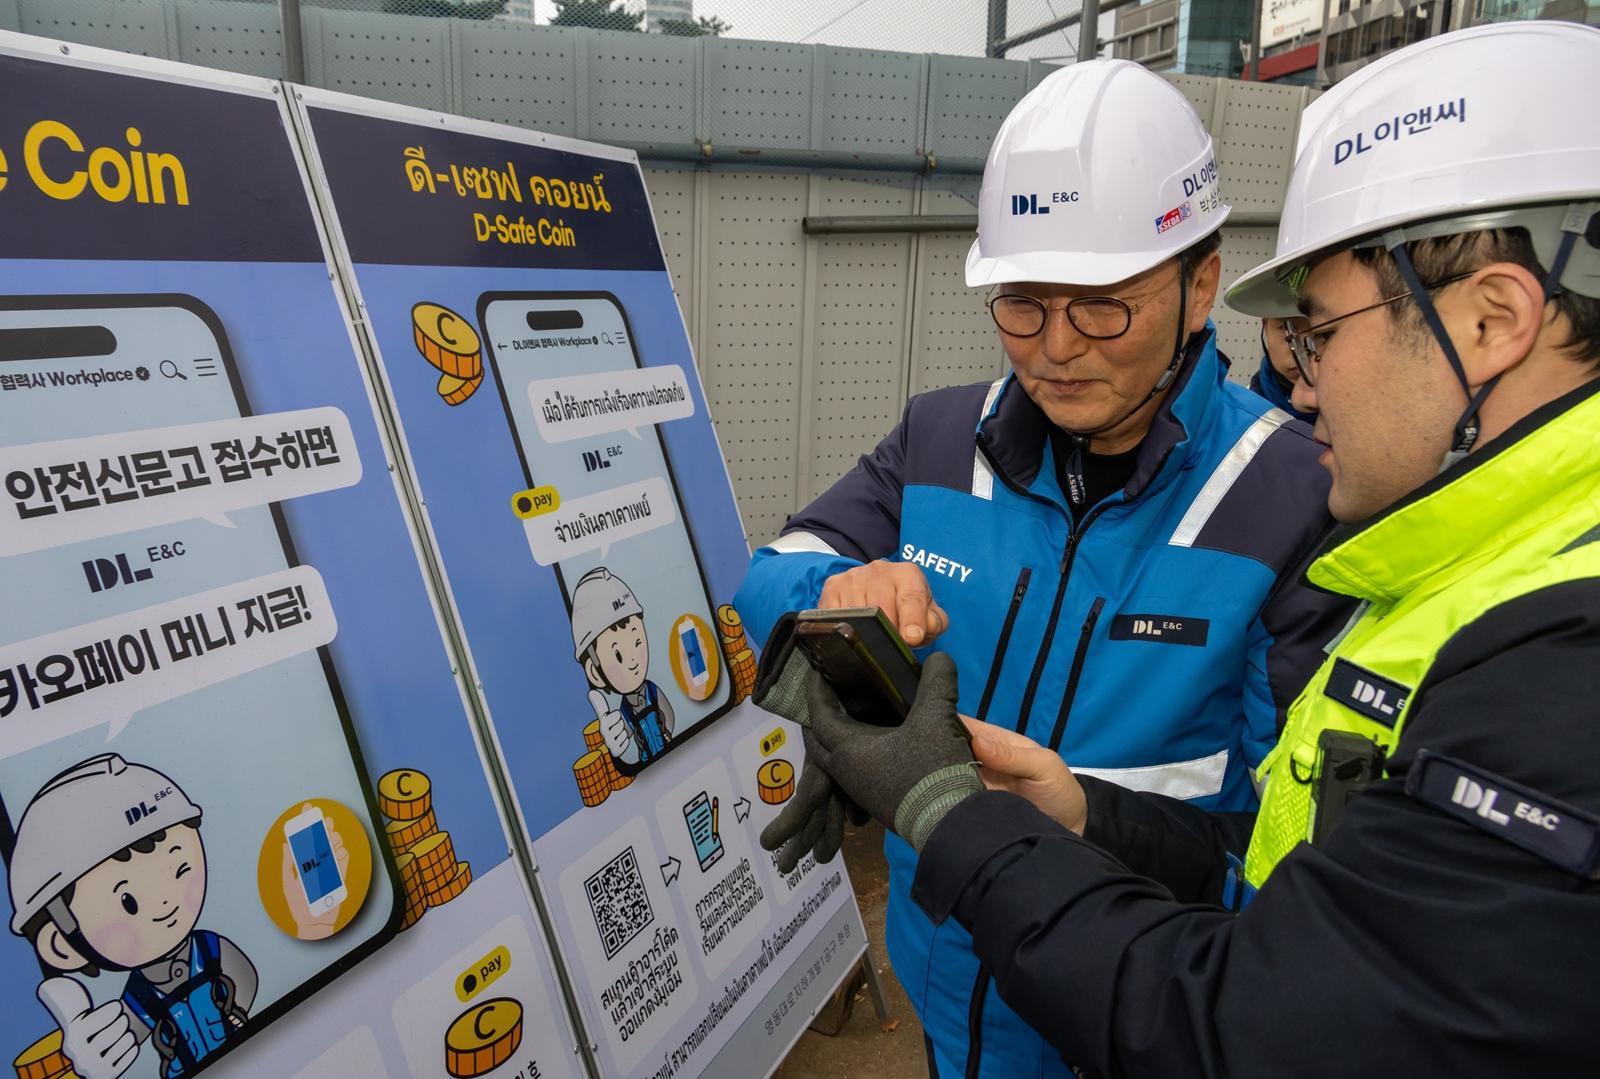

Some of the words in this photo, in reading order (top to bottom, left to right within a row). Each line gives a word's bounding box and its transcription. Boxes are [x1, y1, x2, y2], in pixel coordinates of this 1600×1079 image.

[1333, 97, 1465, 165] DL이앤씨
[23, 119, 190, 206] Coin
[403, 145, 523, 203] ดี-เซฟ
[529, 173, 612, 213] คอยน์
[1182, 157, 1218, 198] DL이앤
[1012, 194, 1050, 215] DL
[1052, 191, 1079, 203] E&C
[473, 212, 536, 245] D-Safe
[537, 217, 576, 247] Coin
[557, 336, 593, 348] Workplace
[0, 371, 46, 391] 협력사
[46, 367, 133, 388] Workplace
[5, 445, 212, 520] 안전신문고
[210, 425, 341, 483] 접수하면
[582, 449, 611, 472] DL
[606, 445, 623, 457] E&C
[533, 492, 552, 509] pay
[82, 552, 154, 593] DL
[147, 540, 187, 563] E&C
[902, 543, 973, 583] SAFETY
[1132, 619, 1162, 635] DL
[1162, 621, 1183, 631] E&C
[0, 628, 160, 718] 카오페이
[160, 605, 237, 662] 머니
[236, 584, 312, 639] 지급!
[1351, 679, 1394, 715] DL
[770, 733, 782, 746] pay
[125, 800, 157, 826] DL
[154, 786, 173, 802] E&C
[1451, 775, 1510, 827] DL
[1514, 801, 1560, 831] E&C
[480, 955, 501, 981] pay
